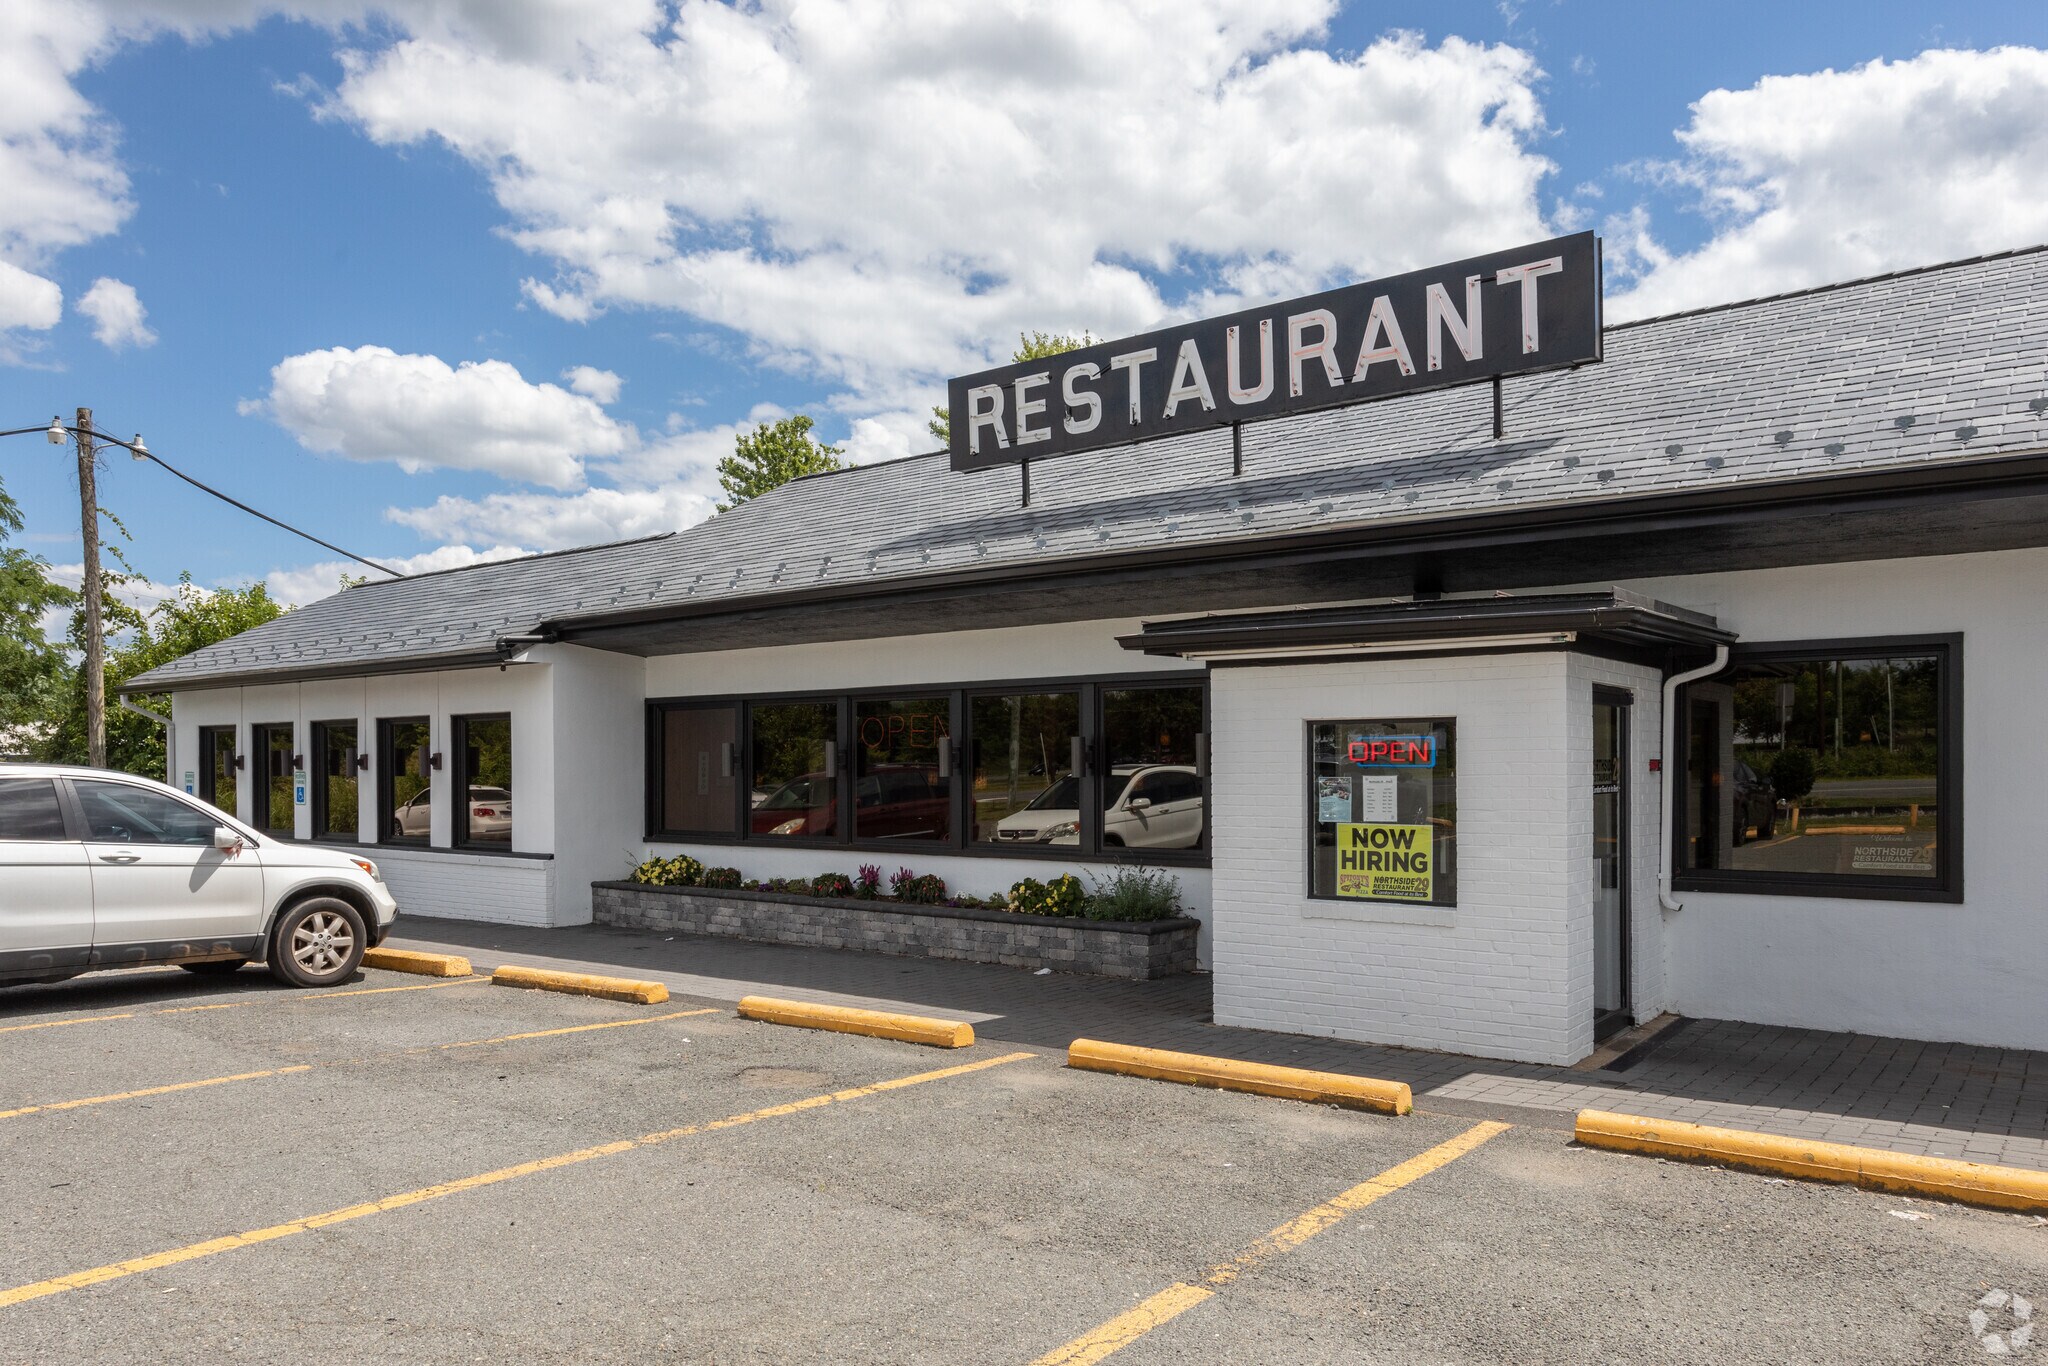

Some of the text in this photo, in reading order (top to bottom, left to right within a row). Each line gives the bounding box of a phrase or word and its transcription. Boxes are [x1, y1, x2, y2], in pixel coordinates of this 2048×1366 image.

[967, 256, 1563, 456] RESTAURANT
[861, 713, 949, 749] OPEN
[1348, 741, 1429, 763] OPEN
[1351, 828, 1416, 850] NOW
[1341, 849, 1428, 874] HIRING
[1853, 855, 1912, 863] RESTAURANT
[1854, 846, 1933, 863] NORTHSIDE 29
[1373, 876, 1430, 892] NORTHSIDE 29
[1373, 883, 1415, 891] RESTAURANT
